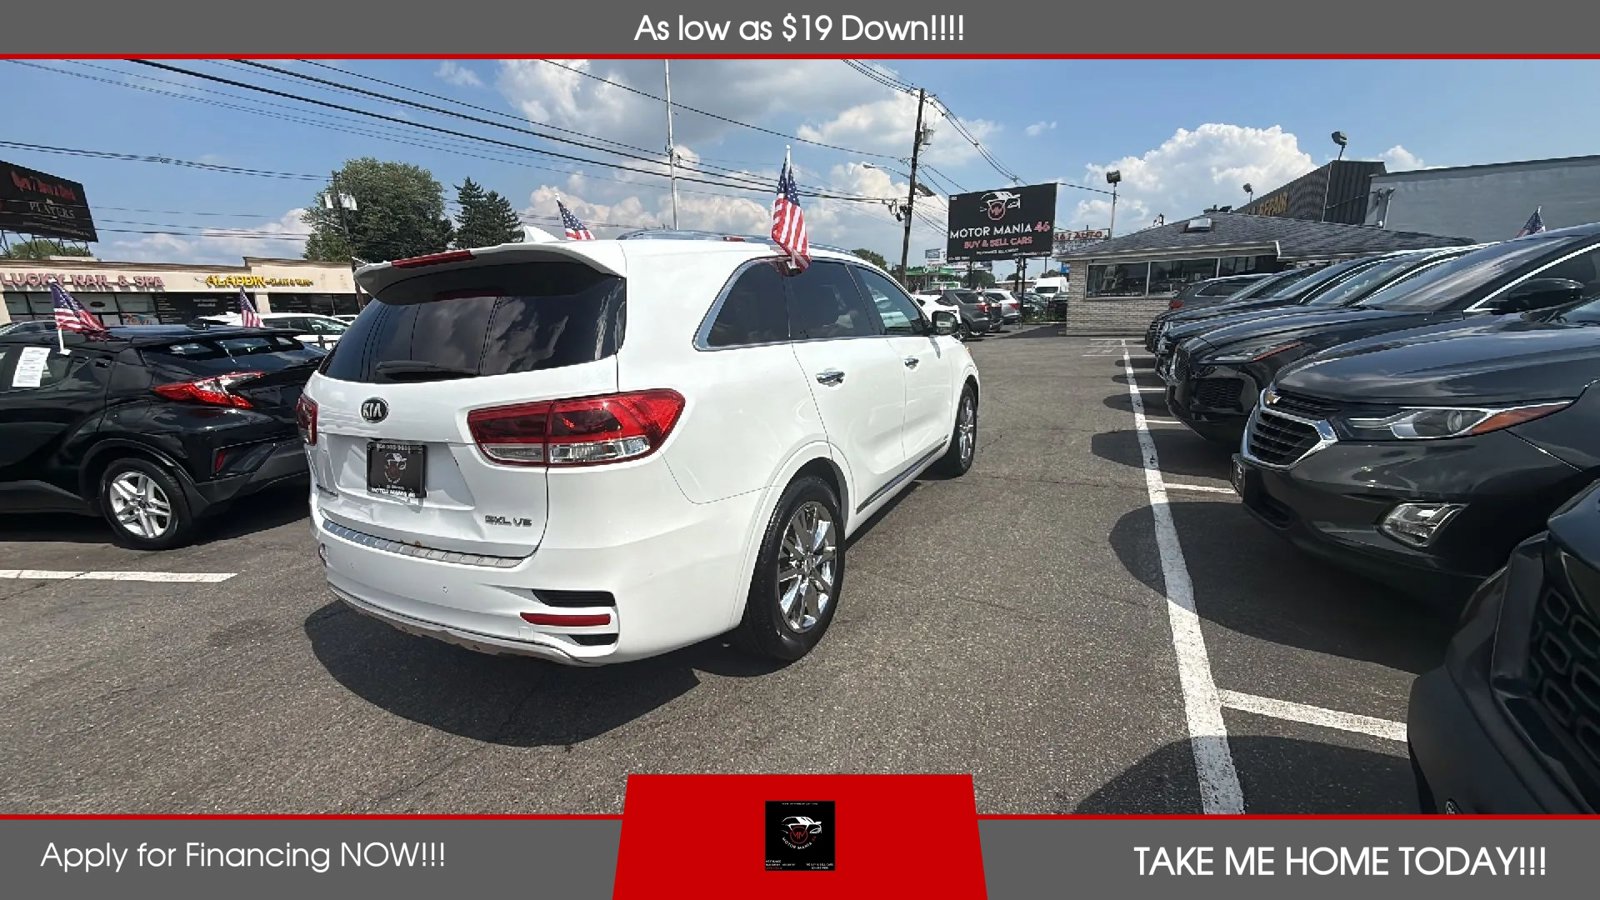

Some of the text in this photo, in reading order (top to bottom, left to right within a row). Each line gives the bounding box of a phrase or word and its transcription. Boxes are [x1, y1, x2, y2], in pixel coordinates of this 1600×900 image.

[950, 221, 1051, 239] MOTOR MANIA 46
[964, 240, 980, 249] BUY
[990, 238, 1009, 247] SELL
[1010, 236, 1033, 245] CARS
[0, 272, 165, 288] LUCKY NAIL & SPA
[205, 274, 267, 288] ALADDIN
[362, 402, 383, 418] KIA
